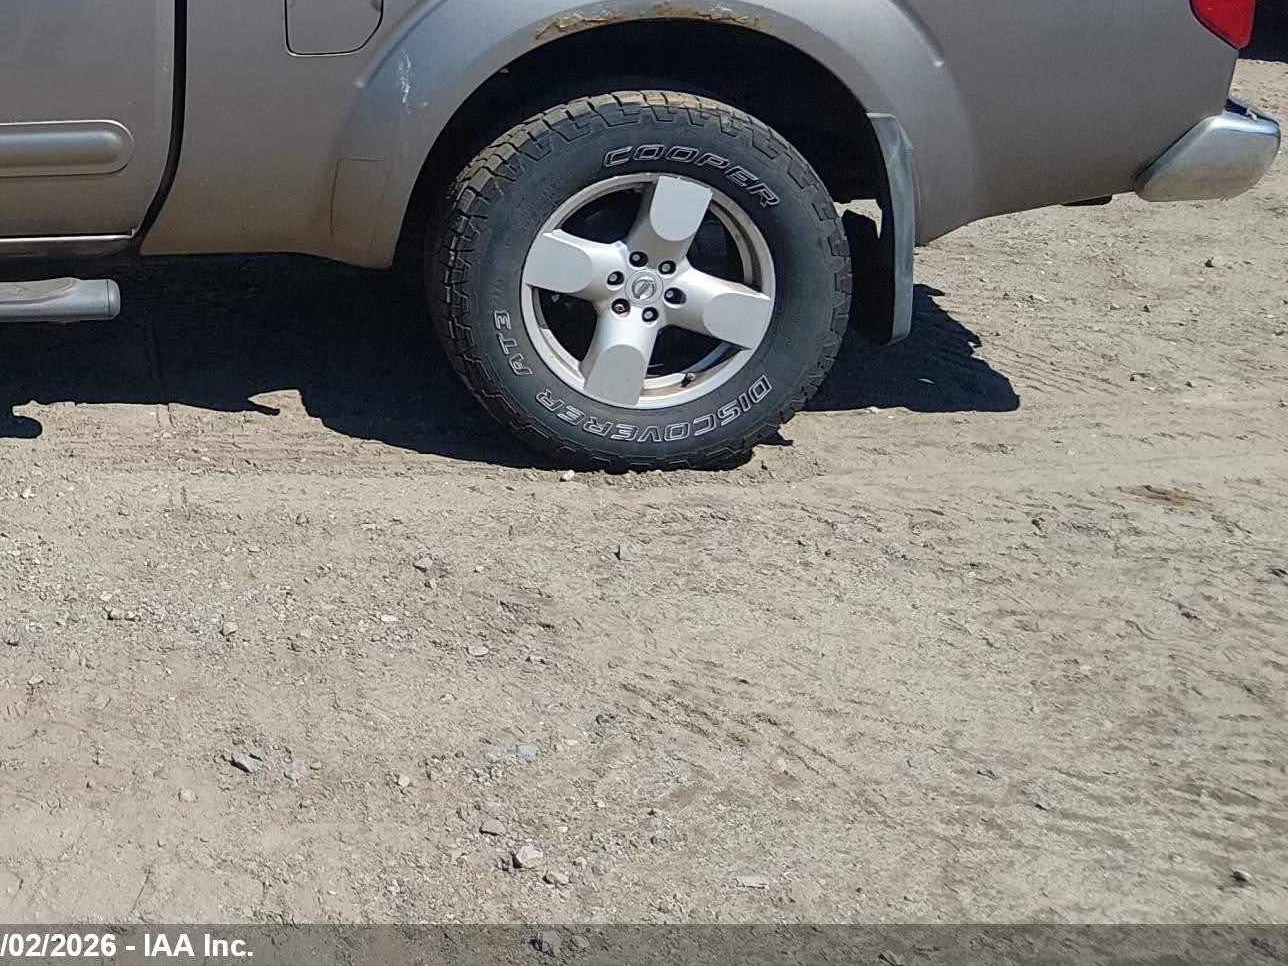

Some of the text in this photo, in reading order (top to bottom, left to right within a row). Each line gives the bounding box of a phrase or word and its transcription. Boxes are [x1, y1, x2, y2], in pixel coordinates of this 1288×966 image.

[602, 144, 781, 209] COOPER
[492, 309, 773, 443] DISCOVERER AT3
